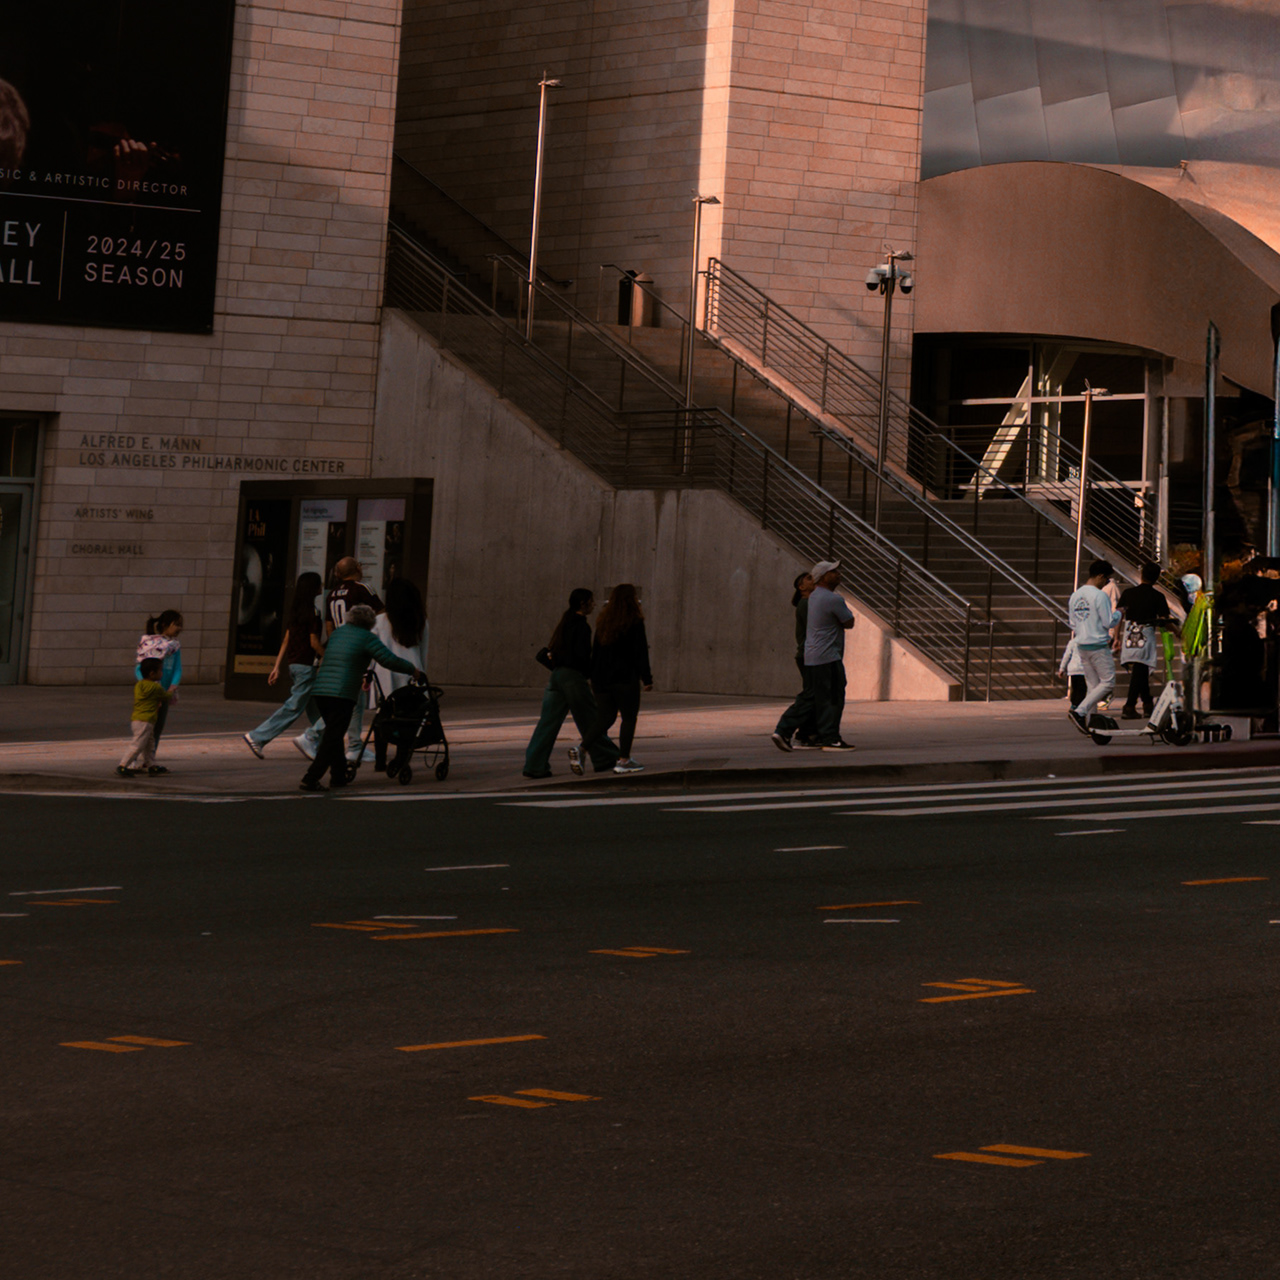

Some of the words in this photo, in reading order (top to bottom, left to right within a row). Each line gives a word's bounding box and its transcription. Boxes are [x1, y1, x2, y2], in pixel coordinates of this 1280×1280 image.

[28, 170, 37, 182] &
[44, 172, 110, 189] ARTISTIC
[117, 179, 188, 196] DIRECTOR
[86, 235, 187, 262] 2024/25
[84, 262, 183, 289] SEASON
[80, 434, 135, 449] ALFRED
[141, 436, 153, 450] E.
[160, 437, 201, 451] MANN
[79, 452, 105, 466] LOS
[111, 453, 176, 468] ANGELES
[182, 455, 288, 471] PHILHARMONIC
[293, 459, 345, 473] CENTER
[125, 509, 154, 519] WING
[248, 522, 267, 537] Phil
[72, 544, 114, 555] CHORAL
[118, 545, 144, 555] HALL
